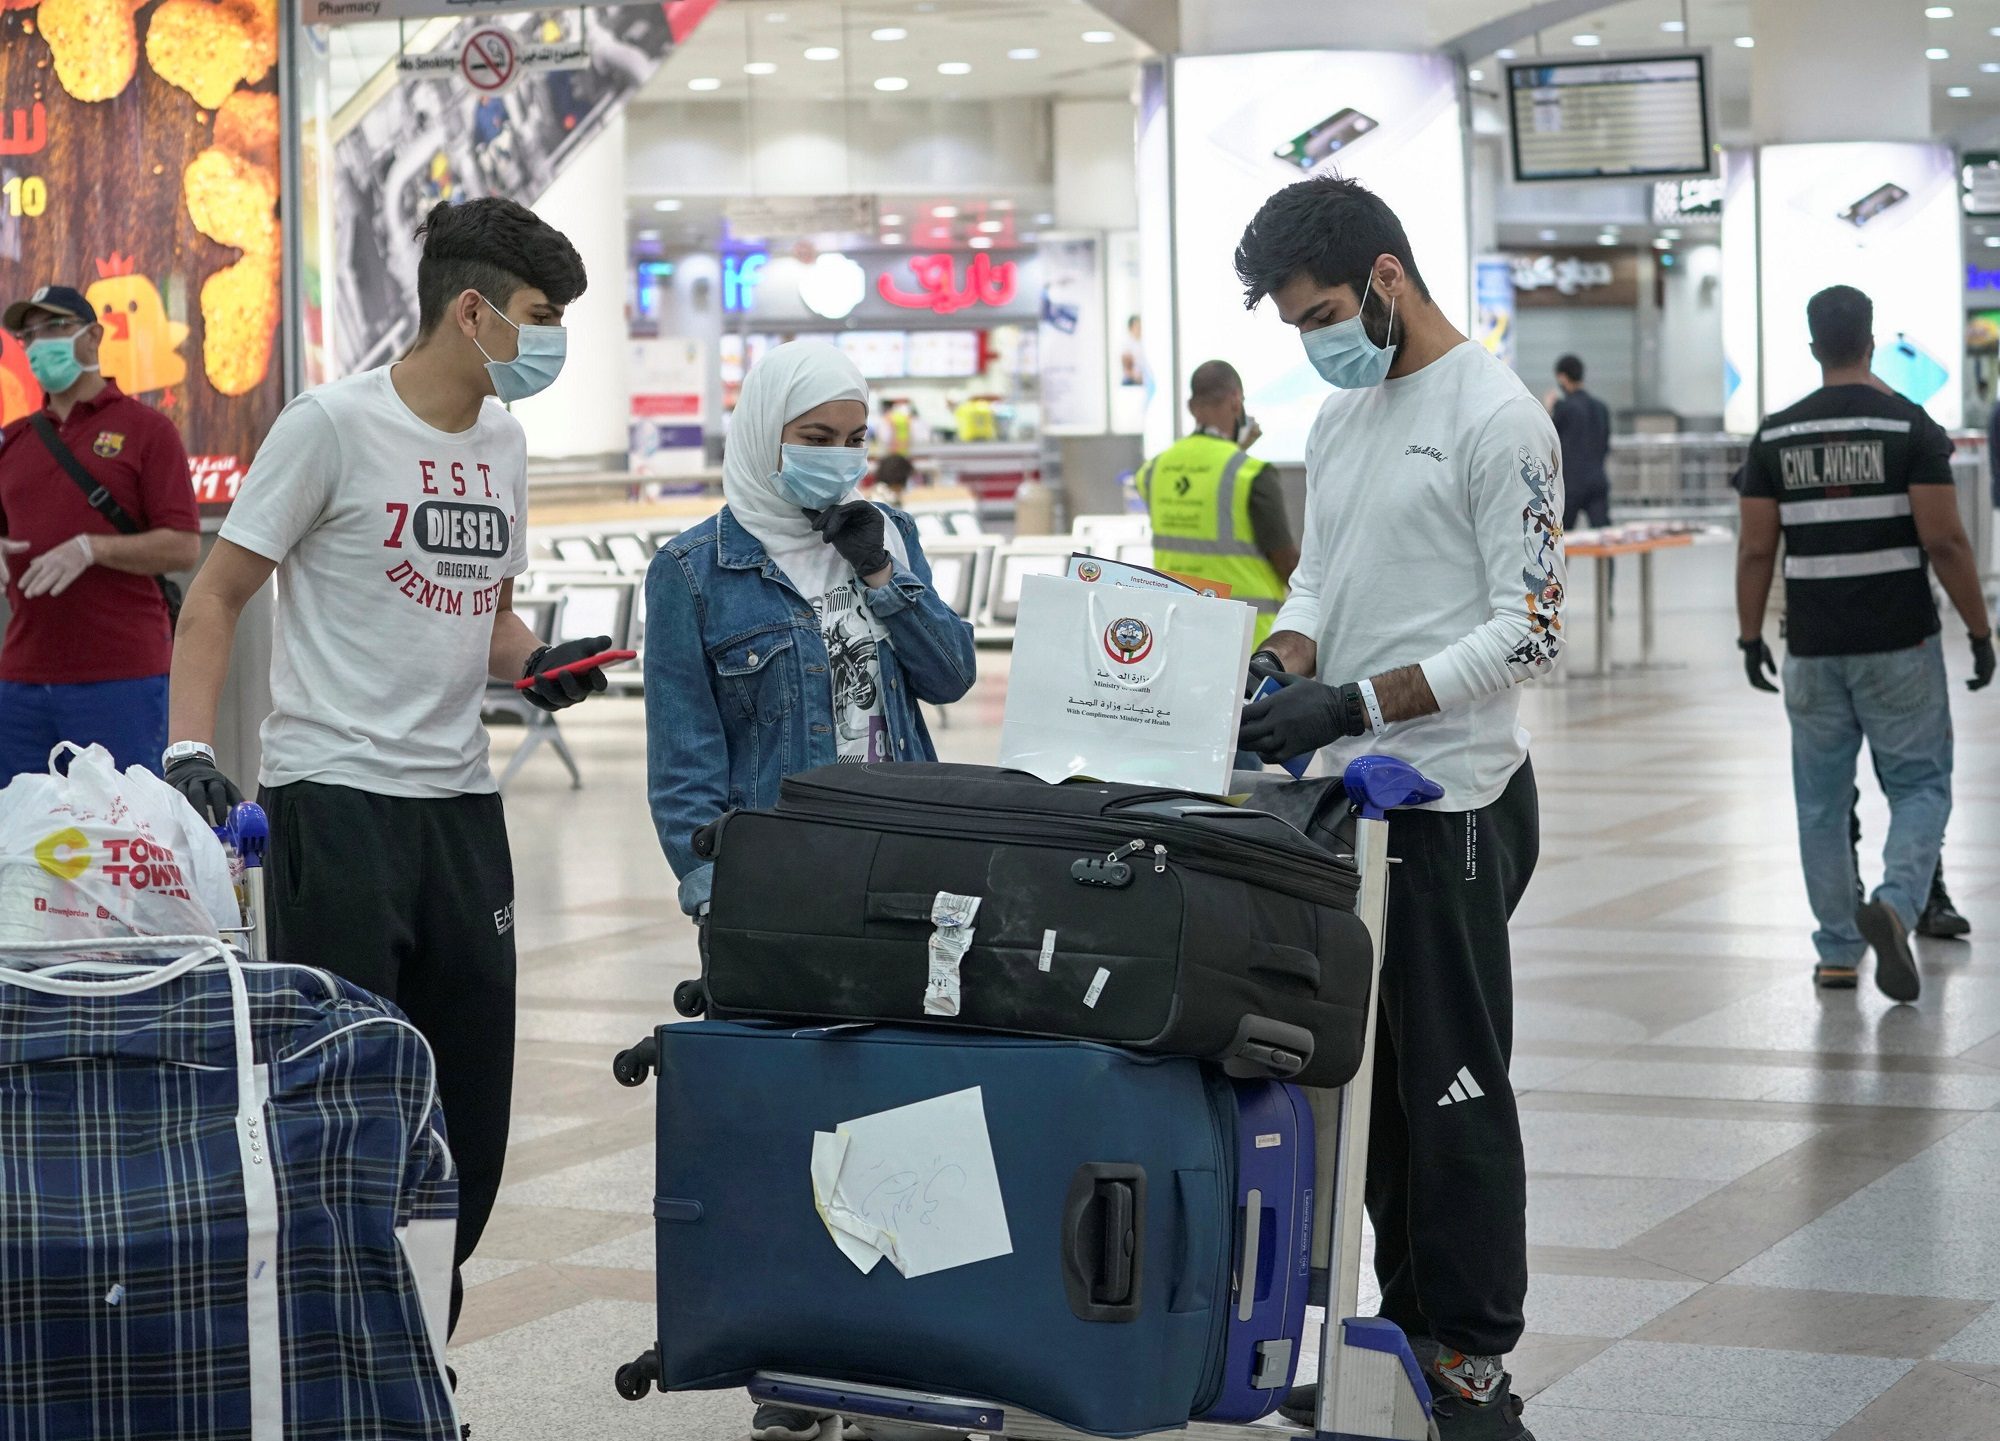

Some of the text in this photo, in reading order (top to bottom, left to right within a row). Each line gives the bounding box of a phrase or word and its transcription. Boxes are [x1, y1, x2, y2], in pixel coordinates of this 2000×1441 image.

[318, 1, 380, 16] Pharmacy
[401, 56, 456, 71] No Smoking
[2, 176, 47, 217] 10
[1783, 443, 1882, 485] CIVIL AVIATION
[419, 460, 500, 499] EST.
[426, 508, 503, 551] DIESEL
[385, 559, 463, 616] DENIM
[1130, 576, 1169, 589] Instructions
[1093, 680, 1120, 691] Ministry
[1066, 707, 1080, 715] With
[1081, 710, 1118, 720] Compliments
[1120, 714, 1143, 724] Ministry
[1151, 719, 1171, 727] Health
[1068, 697, 1171, 718] مع تحيات وزارة الصحة
[103, 864, 184, 890] TOWN
[931, 978, 947, 987] KWI
